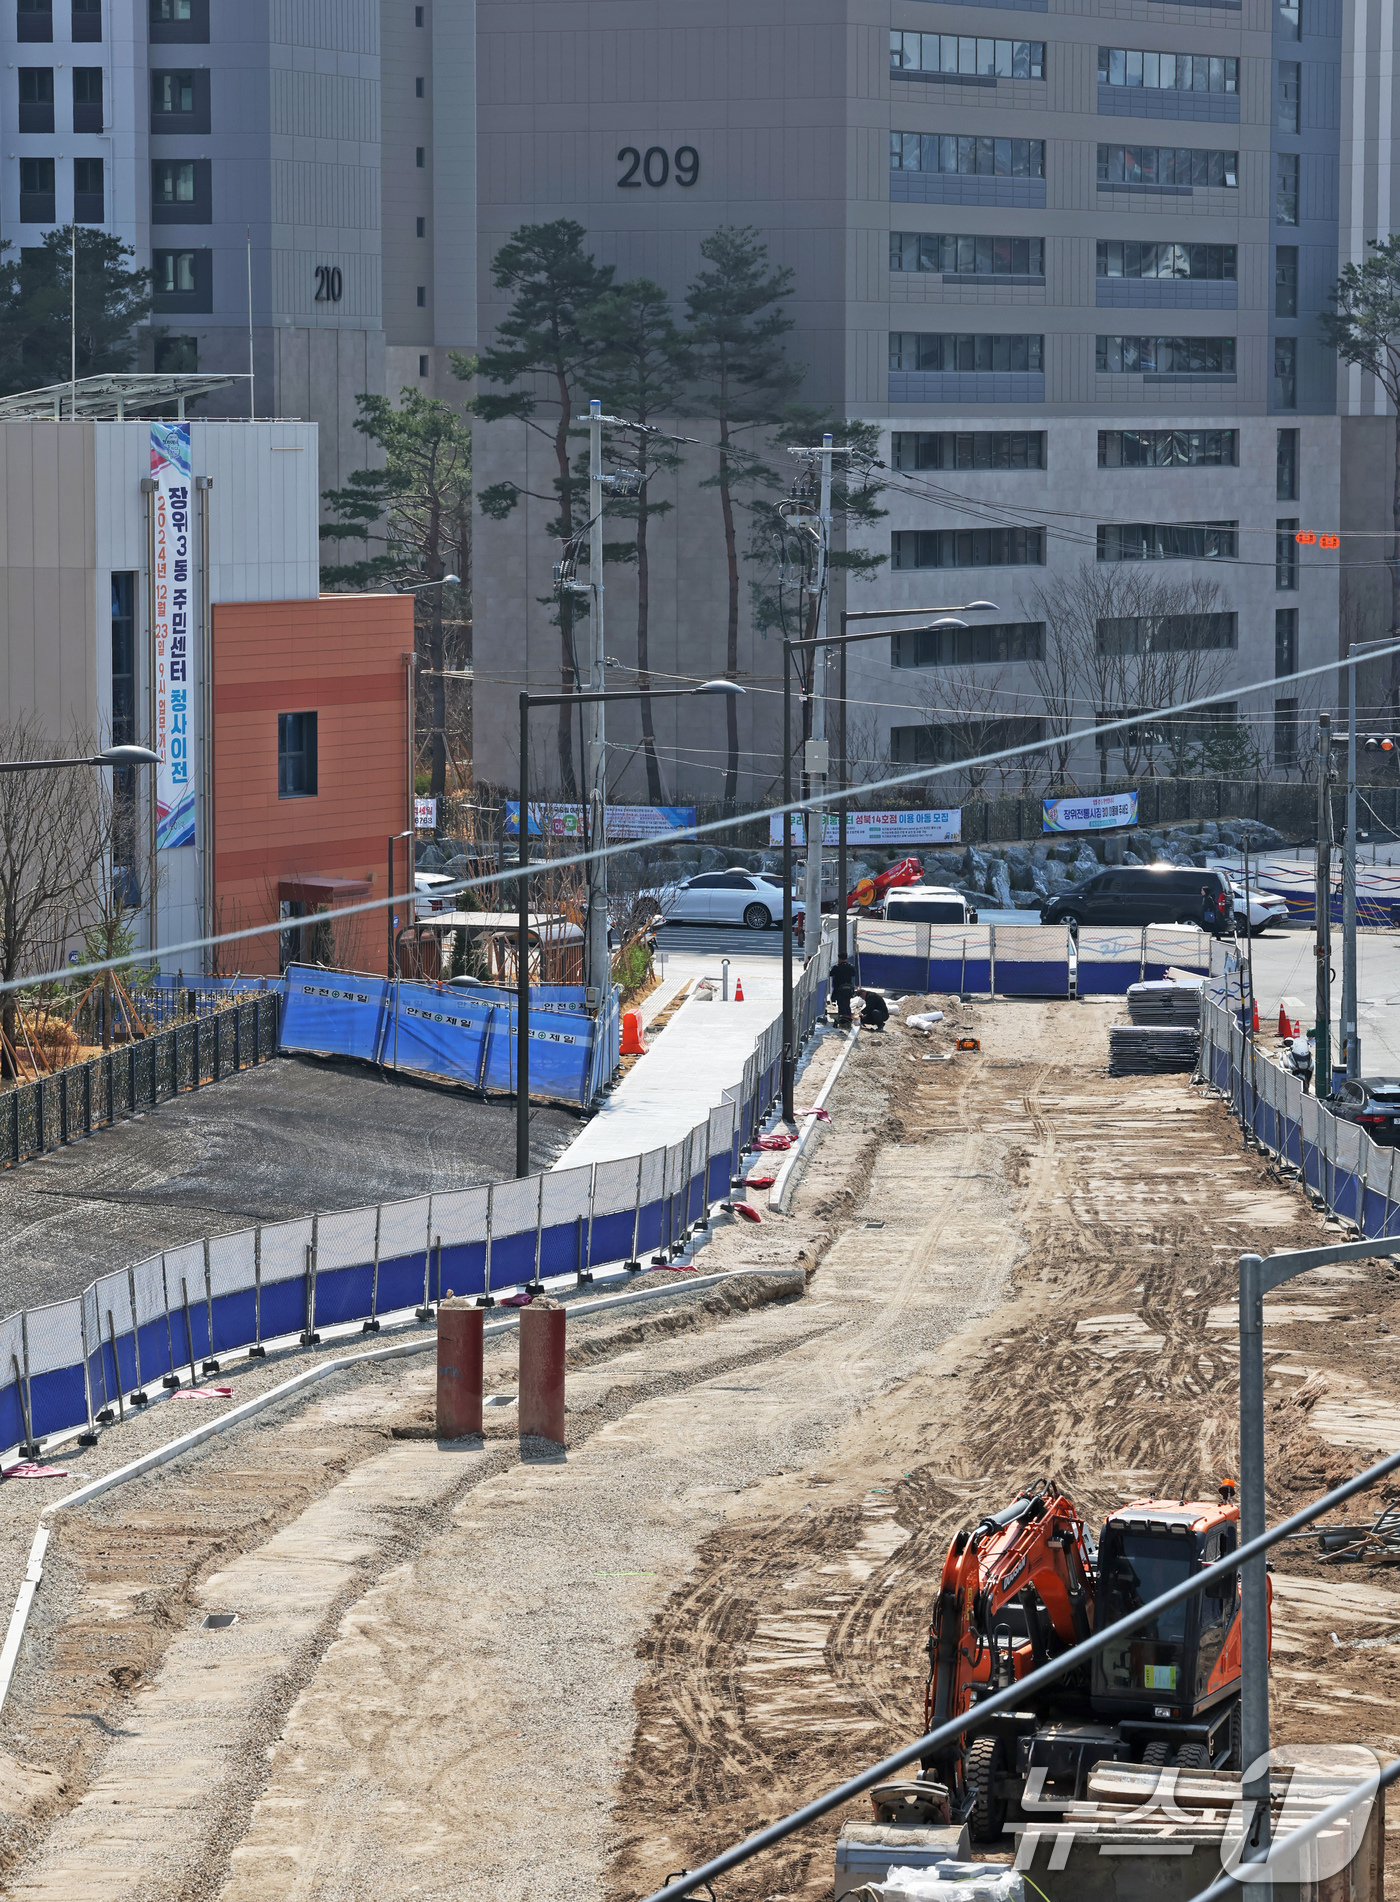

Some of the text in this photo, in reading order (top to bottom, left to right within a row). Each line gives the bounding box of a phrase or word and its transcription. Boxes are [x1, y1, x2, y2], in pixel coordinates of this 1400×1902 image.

[617, 146, 699, 187] 209
[314, 265, 343, 302] 210
[157, 495, 167, 579] 2024년
[156, 584, 167, 617] 12월
[155, 623, 168, 656] 23일
[168, 486, 188, 784] 장위3동 주민센터 청사이전
[158, 662, 166, 695] 9시
[855, 813, 898, 825] 성북14호점
[899, 813, 914, 824] 이용
[916, 813, 931, 823] 아동
[933, 812, 949, 823] 모집
[1063, 807, 1102, 820] 장위전통시장
[303, 985, 329, 997] 안전
[342, 991, 369, 1003] 제일
[407, 1007, 472, 1029] 안전 제일
[549, 1033, 574, 1044] 제일
